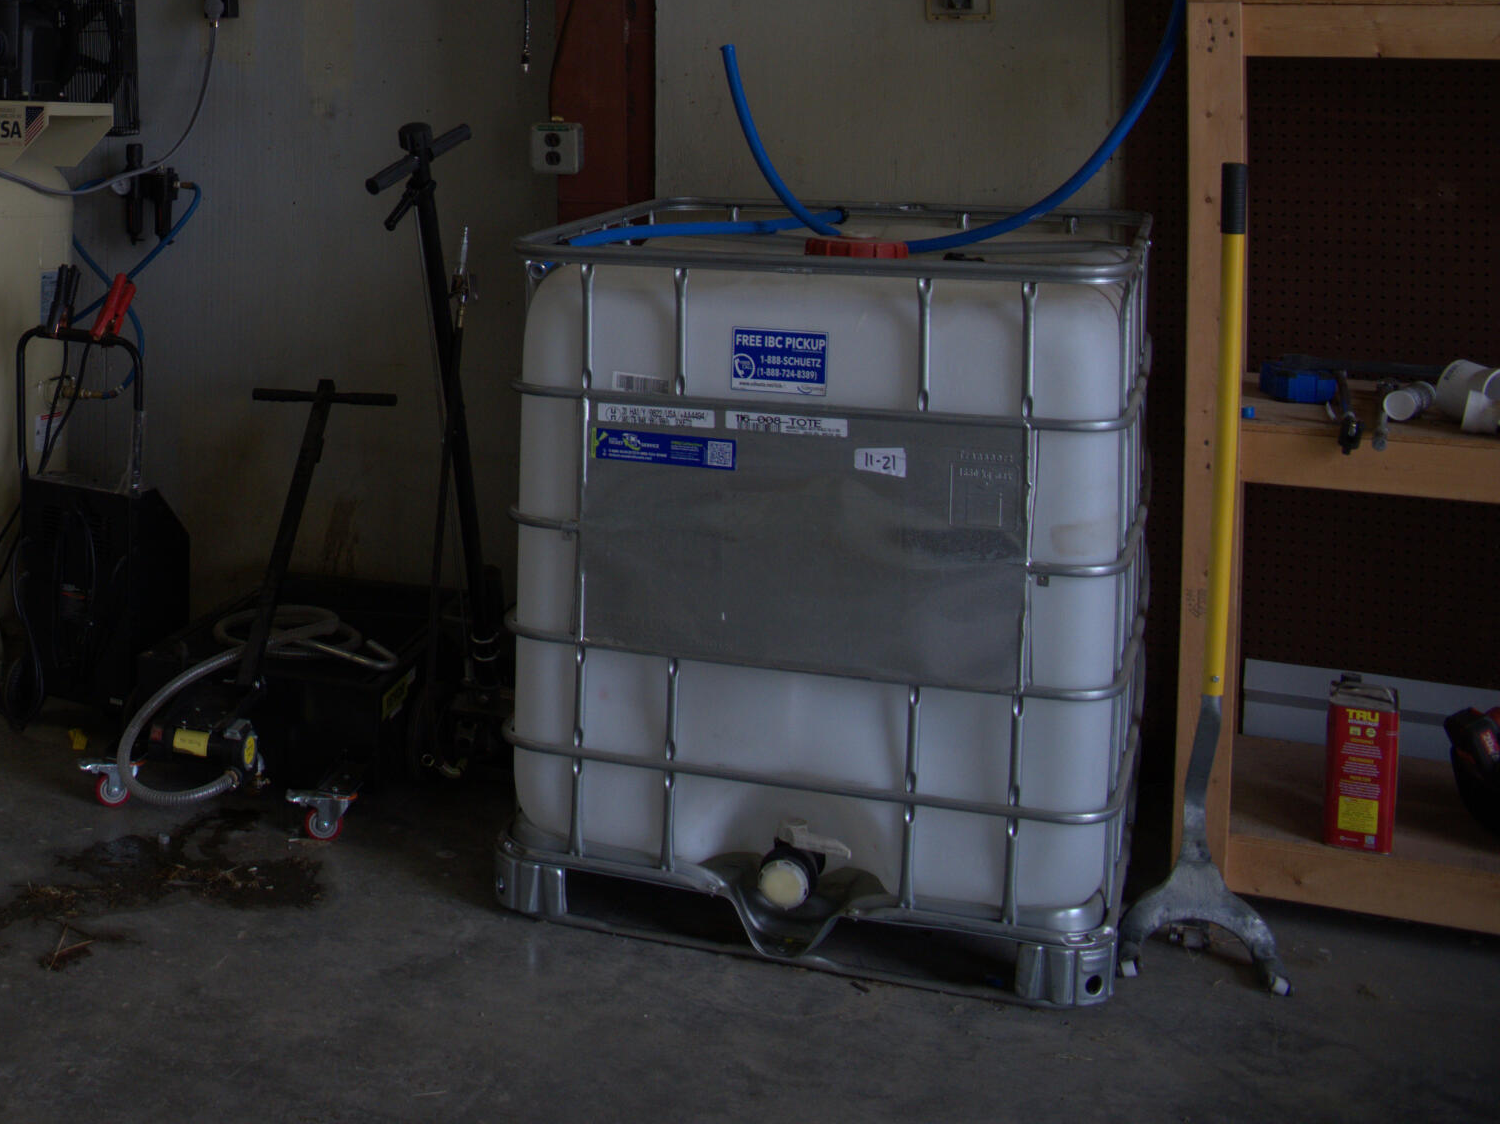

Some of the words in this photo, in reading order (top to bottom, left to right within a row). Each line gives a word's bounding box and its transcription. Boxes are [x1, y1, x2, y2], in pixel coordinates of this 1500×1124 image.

[735, 333, 763, 348] FREE
[764, 335, 784, 349] IBC
[785, 336, 826, 351] PICKUP
[760, 354, 822, 368] 1-888-SCHUETZ
[864, 452, 896, 471] 11-21
